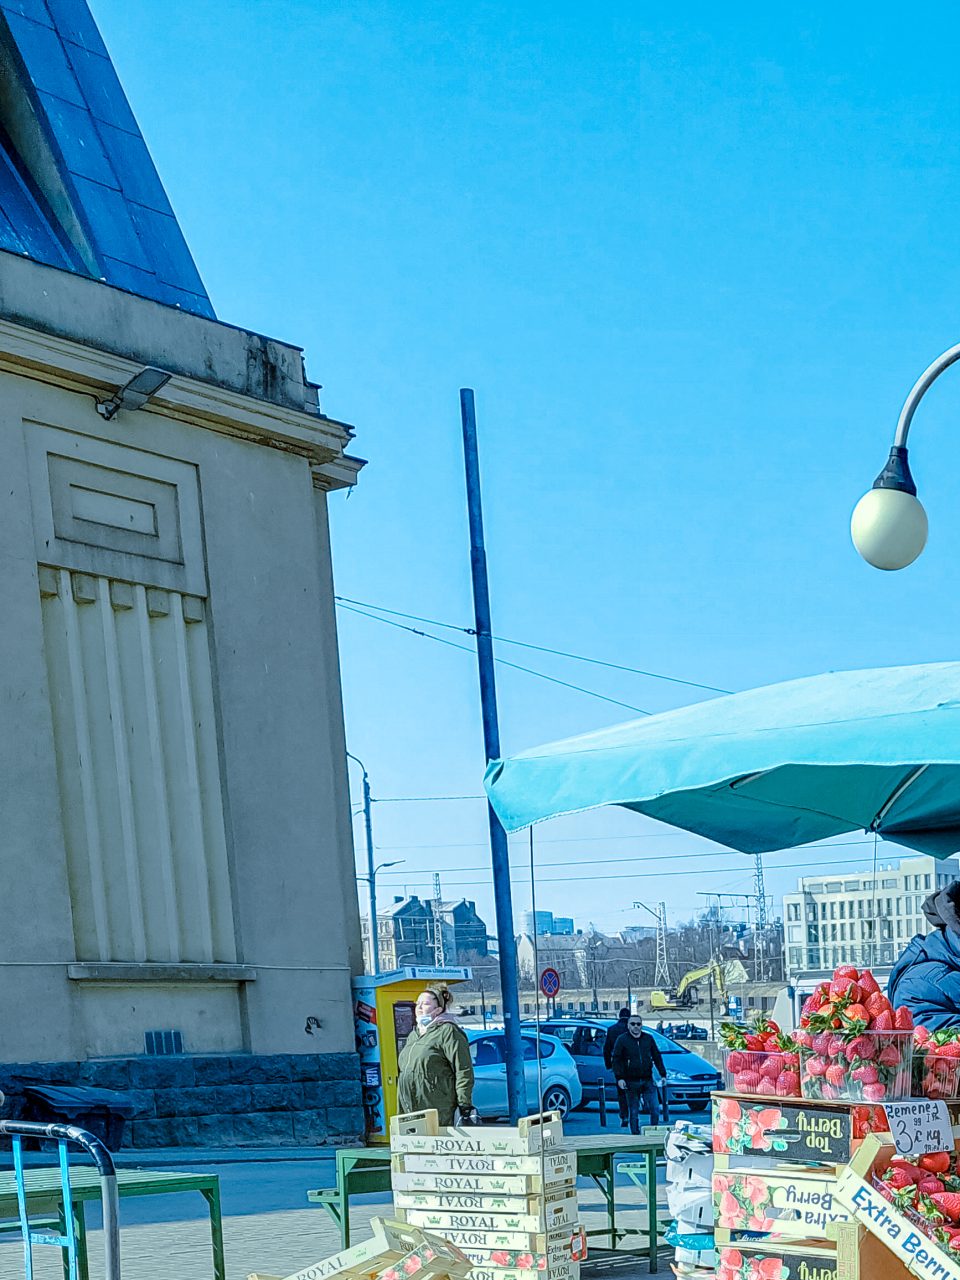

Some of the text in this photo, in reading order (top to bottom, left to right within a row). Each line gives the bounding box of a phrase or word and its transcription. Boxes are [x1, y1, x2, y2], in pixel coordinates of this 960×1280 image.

[796, 1112, 843, 1139] Berry
[434, 1139, 486, 1152] ROYAL
[806, 1134, 832, 1154] Top
[446, 1159, 496, 1171] ROYAL
[434, 1177, 484, 1190] ROYAL
[435, 1197, 484, 1209] ROYAL
[786, 1185, 833, 1211] Berry
[851, 1186, 902, 1240] Extra
[449, 1216, 499, 1229] ROYAL
[440, 1232, 488, 1246] ROYAL
